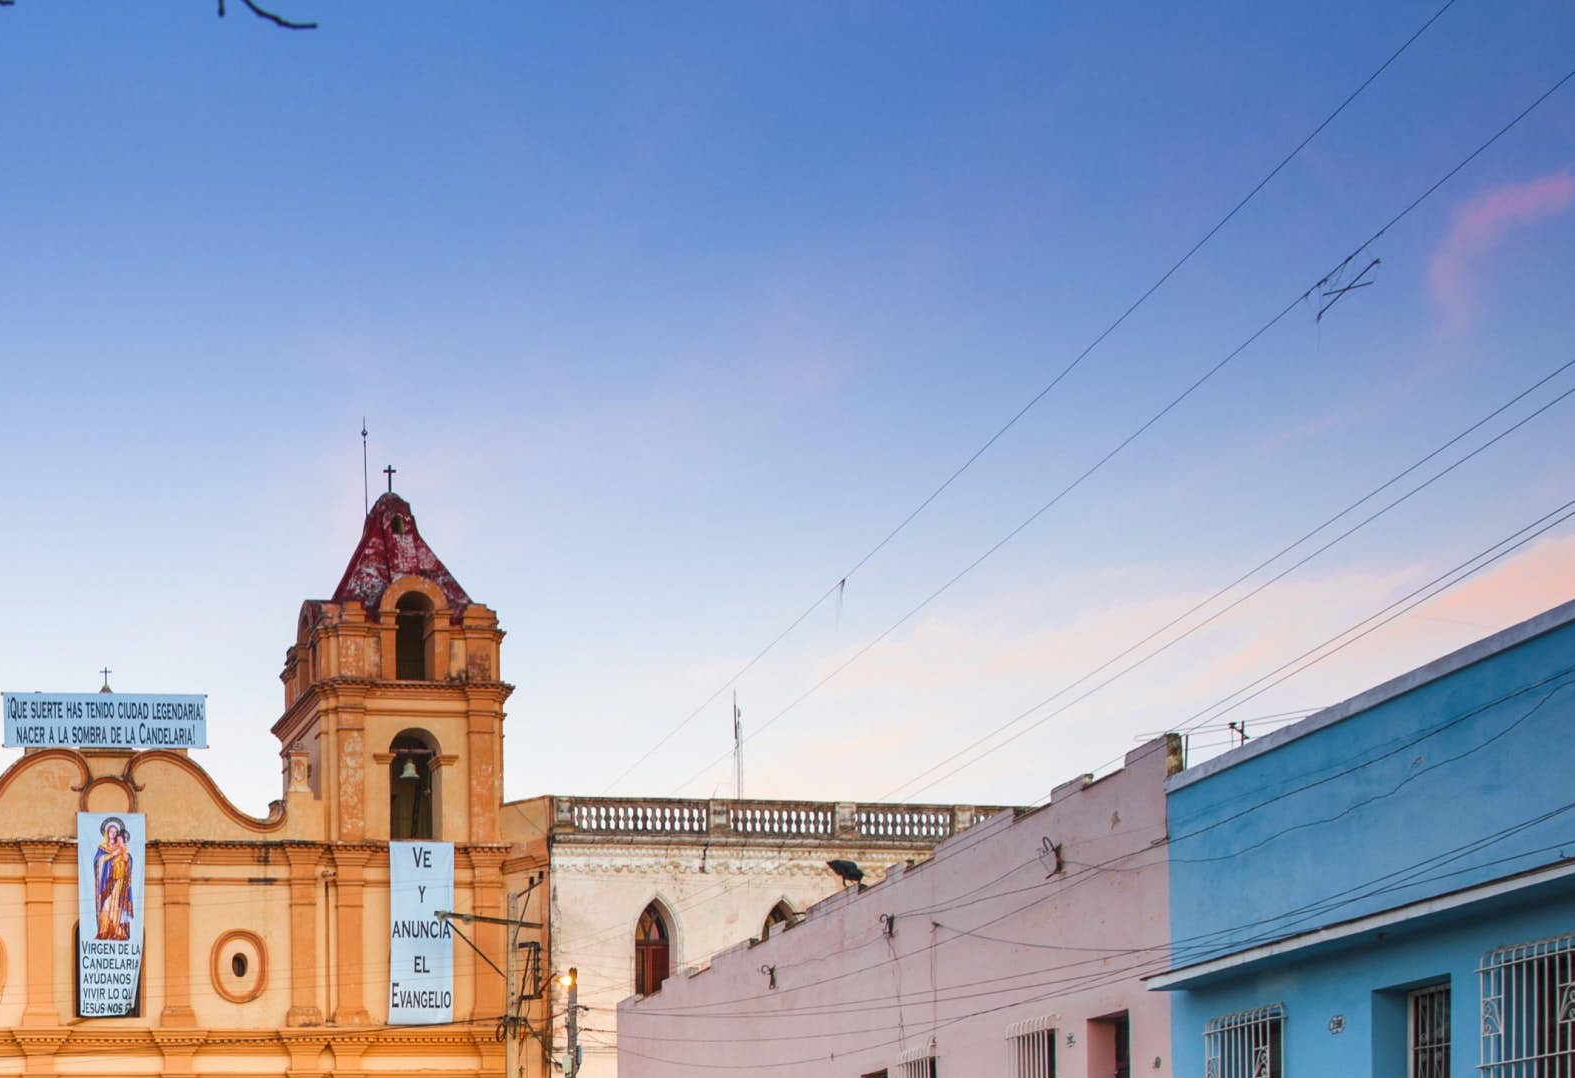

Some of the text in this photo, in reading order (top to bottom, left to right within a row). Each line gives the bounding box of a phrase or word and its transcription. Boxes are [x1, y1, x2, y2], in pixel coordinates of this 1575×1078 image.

[30, 701, 63, 719] SUERTE
[66, 701, 83, 719] HAS
[85, 702, 115, 719] TENIDO
[117, 702, 149, 720] CIUDAD
[16, 726, 45, 744] NACER
[48, 726, 55, 744] A
[57, 726, 69, 744] LA
[71, 726, 108, 744] SOMBRA
[110, 726, 122, 745] DE
[125, 727, 136, 745] LA
[412, 847, 432, 868] VE
[418, 885, 426, 904] Y
[392, 920, 452, 939] ANUNCIA
[82, 941, 141, 956] VIRGEN DE LA
[414, 955, 430, 974] EL
[83, 988, 106, 1000] VIVIR
[108, 988, 120, 1000] LO
[391, 982, 452, 1009] EVANGELIO
[107, 1003, 123, 1013] NOS
